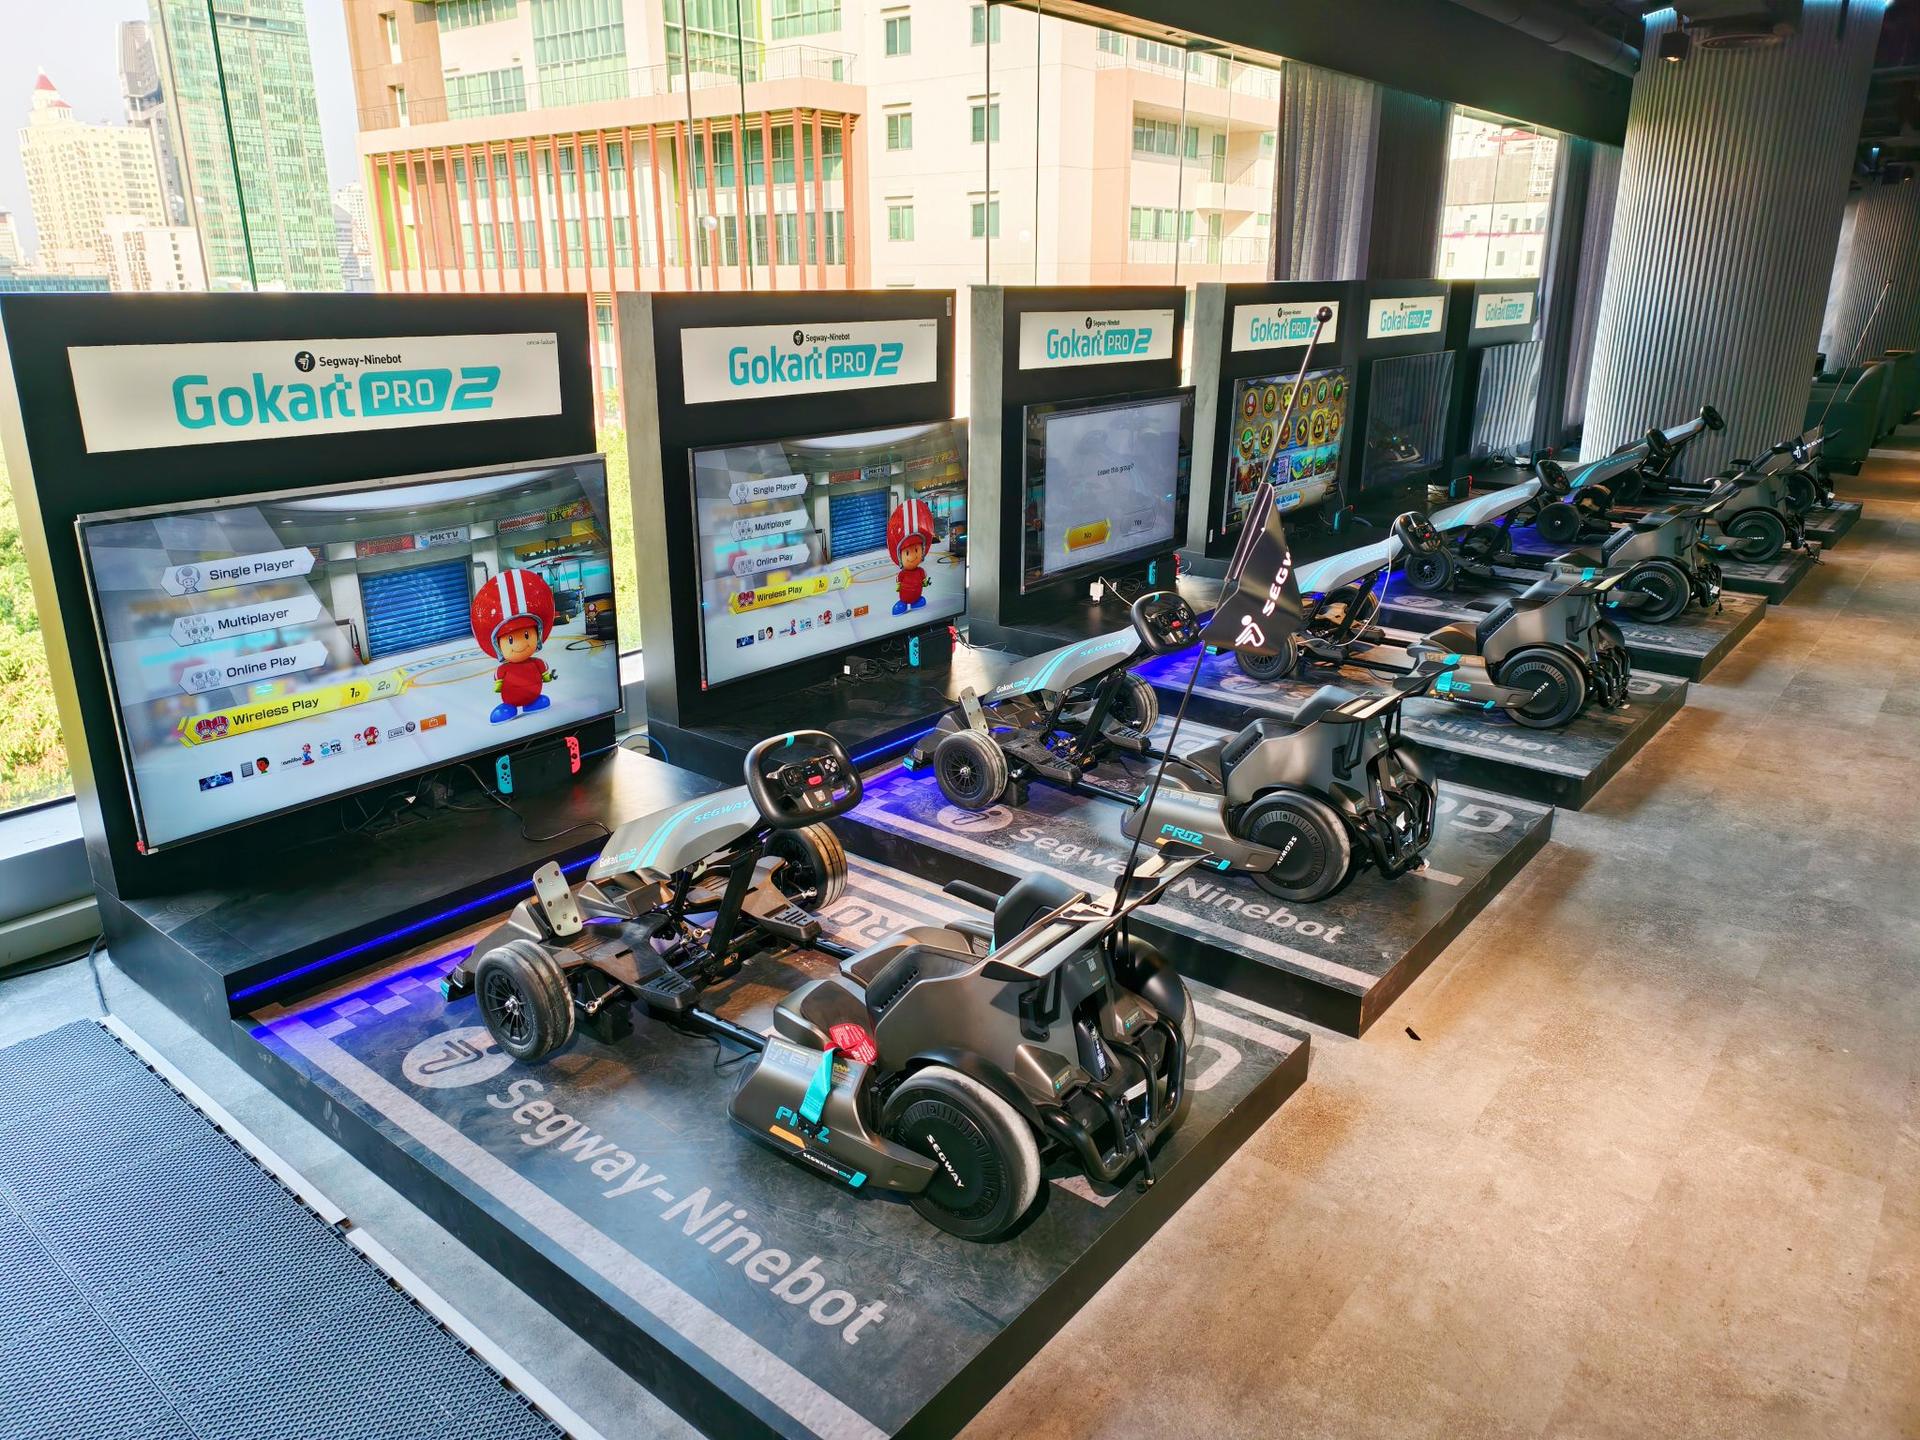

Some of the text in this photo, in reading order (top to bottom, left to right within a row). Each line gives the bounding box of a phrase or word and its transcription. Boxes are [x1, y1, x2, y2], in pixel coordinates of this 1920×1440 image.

[805, 332, 850, 343] Segway-Ninebot
[1250, 316, 1288, 342] Gokart
[1291, 321, 1307, 336] PRO
[1046, 328, 1153, 360] Gokart PRO 2
[319, 353, 402, 368] Segway-Ninebot
[728, 342, 904, 386] Gokart PRO 2
[172, 366, 501, 430] Gokart PRO 2
[753, 483, 797, 495] Single Player
[755, 518, 792, 531] Multiplayer
[430, 531, 459, 542] MKTV
[209, 558, 295, 580] Single Player
[756, 553, 793, 568] Online Play
[757, 585, 803, 602] Wireless Play
[1642, 586, 1664, 601] SEGWAY
[217, 608, 290, 630] Multiplayer
[226, 654, 297, 678] Online Play
[232, 696, 320, 726] Wireless Play
[693, 799, 753, 825] SEGWAY
[1276, 835, 1298, 866] SEGWAY
[926, 1134, 965, 1188] SEGWAY
[486, 1078, 888, 1346] Segway-Ninebot
